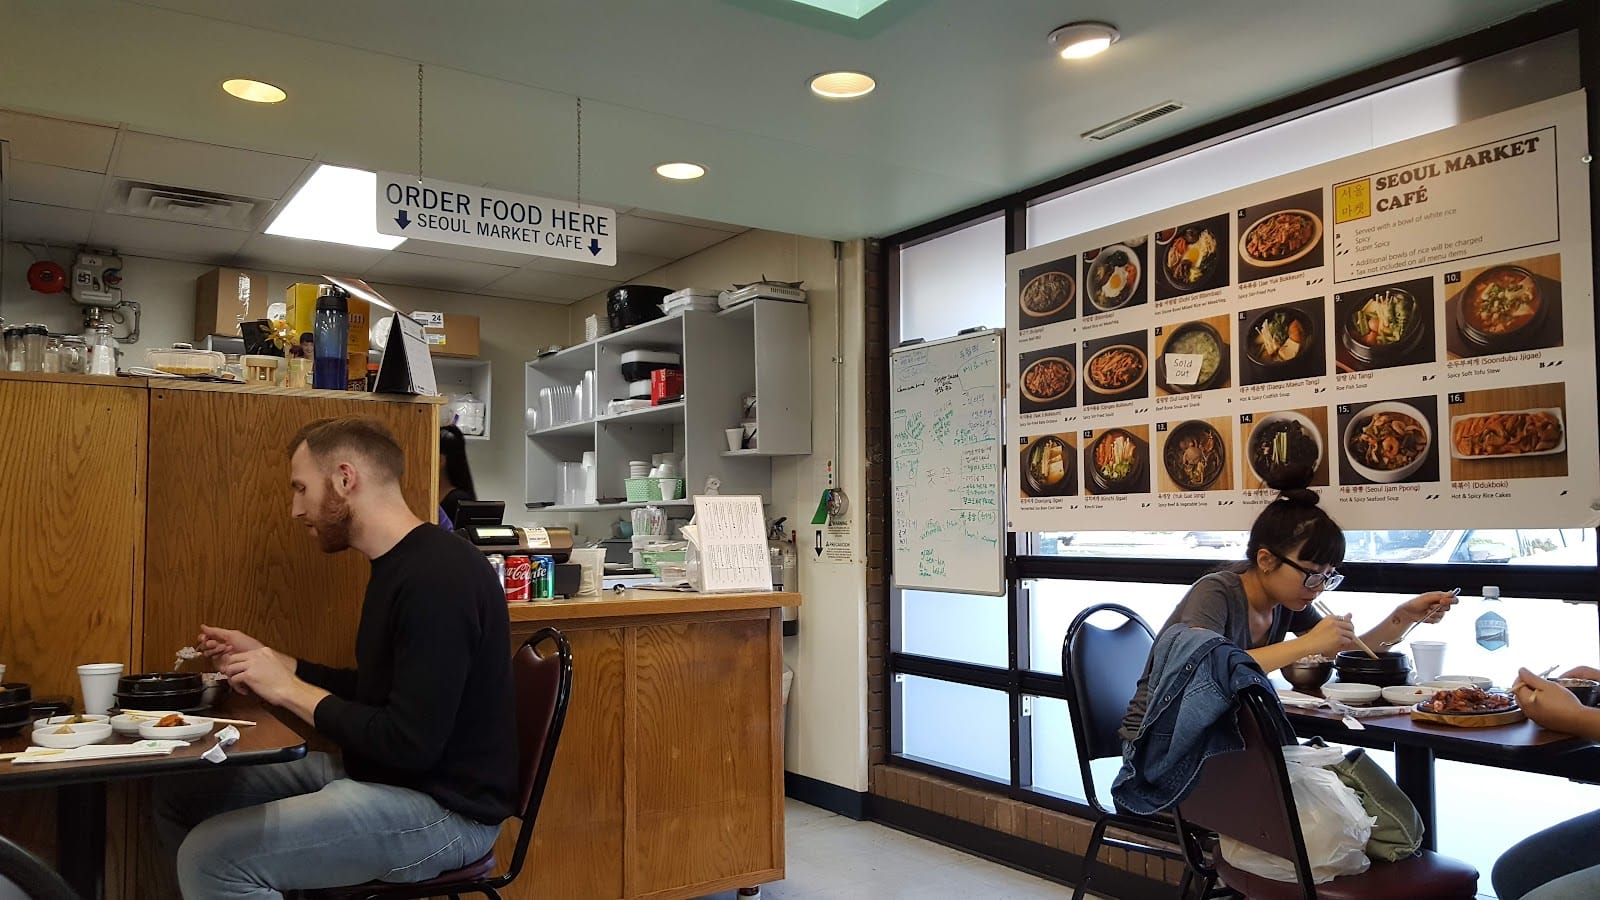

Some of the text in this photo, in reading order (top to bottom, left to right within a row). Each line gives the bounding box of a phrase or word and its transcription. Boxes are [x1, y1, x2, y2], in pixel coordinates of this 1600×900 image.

[1376, 136, 1540, 191] SEOUL MARKET
[1341, 184, 1364, 198] 서울
[1376, 185, 1428, 212] CAFÉ
[386, 183, 609, 236] ORDER FOOD HERE
[1355, 226, 1376, 236] Served
[1377, 222, 1391, 232] with
[1398, 217, 1414, 226] bowl
[1424, 211, 1442, 221] white
[1444, 208, 1456, 216] rice
[417, 213, 583, 250] SEOUL MARKET CAFE
[1355, 236, 1370, 245] Spicy
[1355, 240, 1390, 252] Super Spicy
[1356, 235, 1483, 267] Additional bowls of rice will be charged
[1356, 268, 1366, 276] Tax
[1367, 266, 1378, 274] not
[1379, 260, 1407, 272] included
[1418, 256, 1426, 264] all
[1427, 254, 1447, 262] menu
[1448, 250, 1467, 259] items
[1446, 274, 1458, 282] 10.
[432, 314, 441, 322] 24
[1174, 359, 1192, 367] Sold
[1482, 355, 1518, 365] (Soondubu
[1450, 394, 1462, 402] 16.
[1338, 405, 1350, 413] 15.
